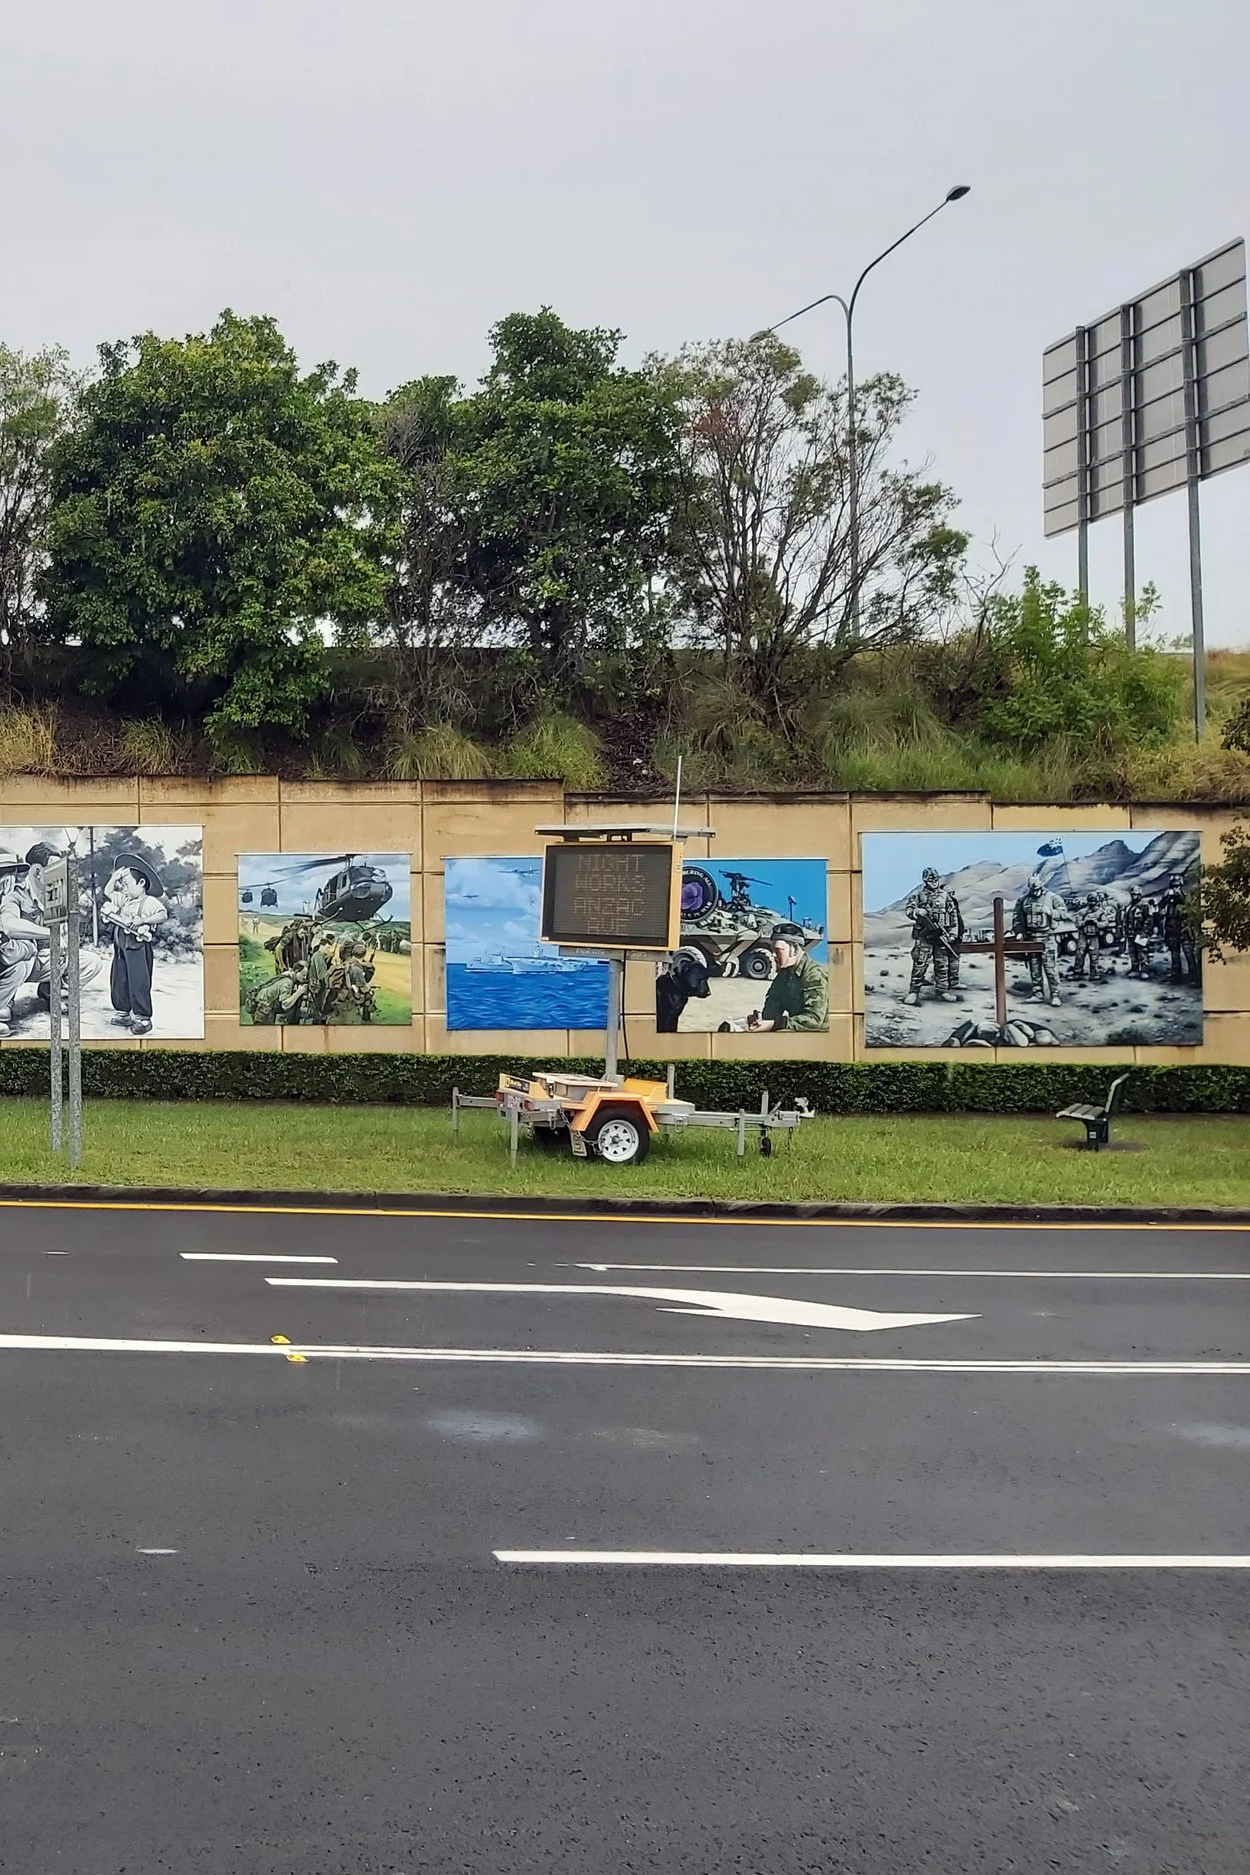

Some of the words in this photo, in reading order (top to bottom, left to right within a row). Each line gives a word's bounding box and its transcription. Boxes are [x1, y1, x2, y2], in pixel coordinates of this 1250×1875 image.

[578, 854, 645, 871] NIGHT
[575, 874, 646, 892] WORKS
[574, 897, 645, 916] ANZAC
[587, 917, 630, 936] AVE
